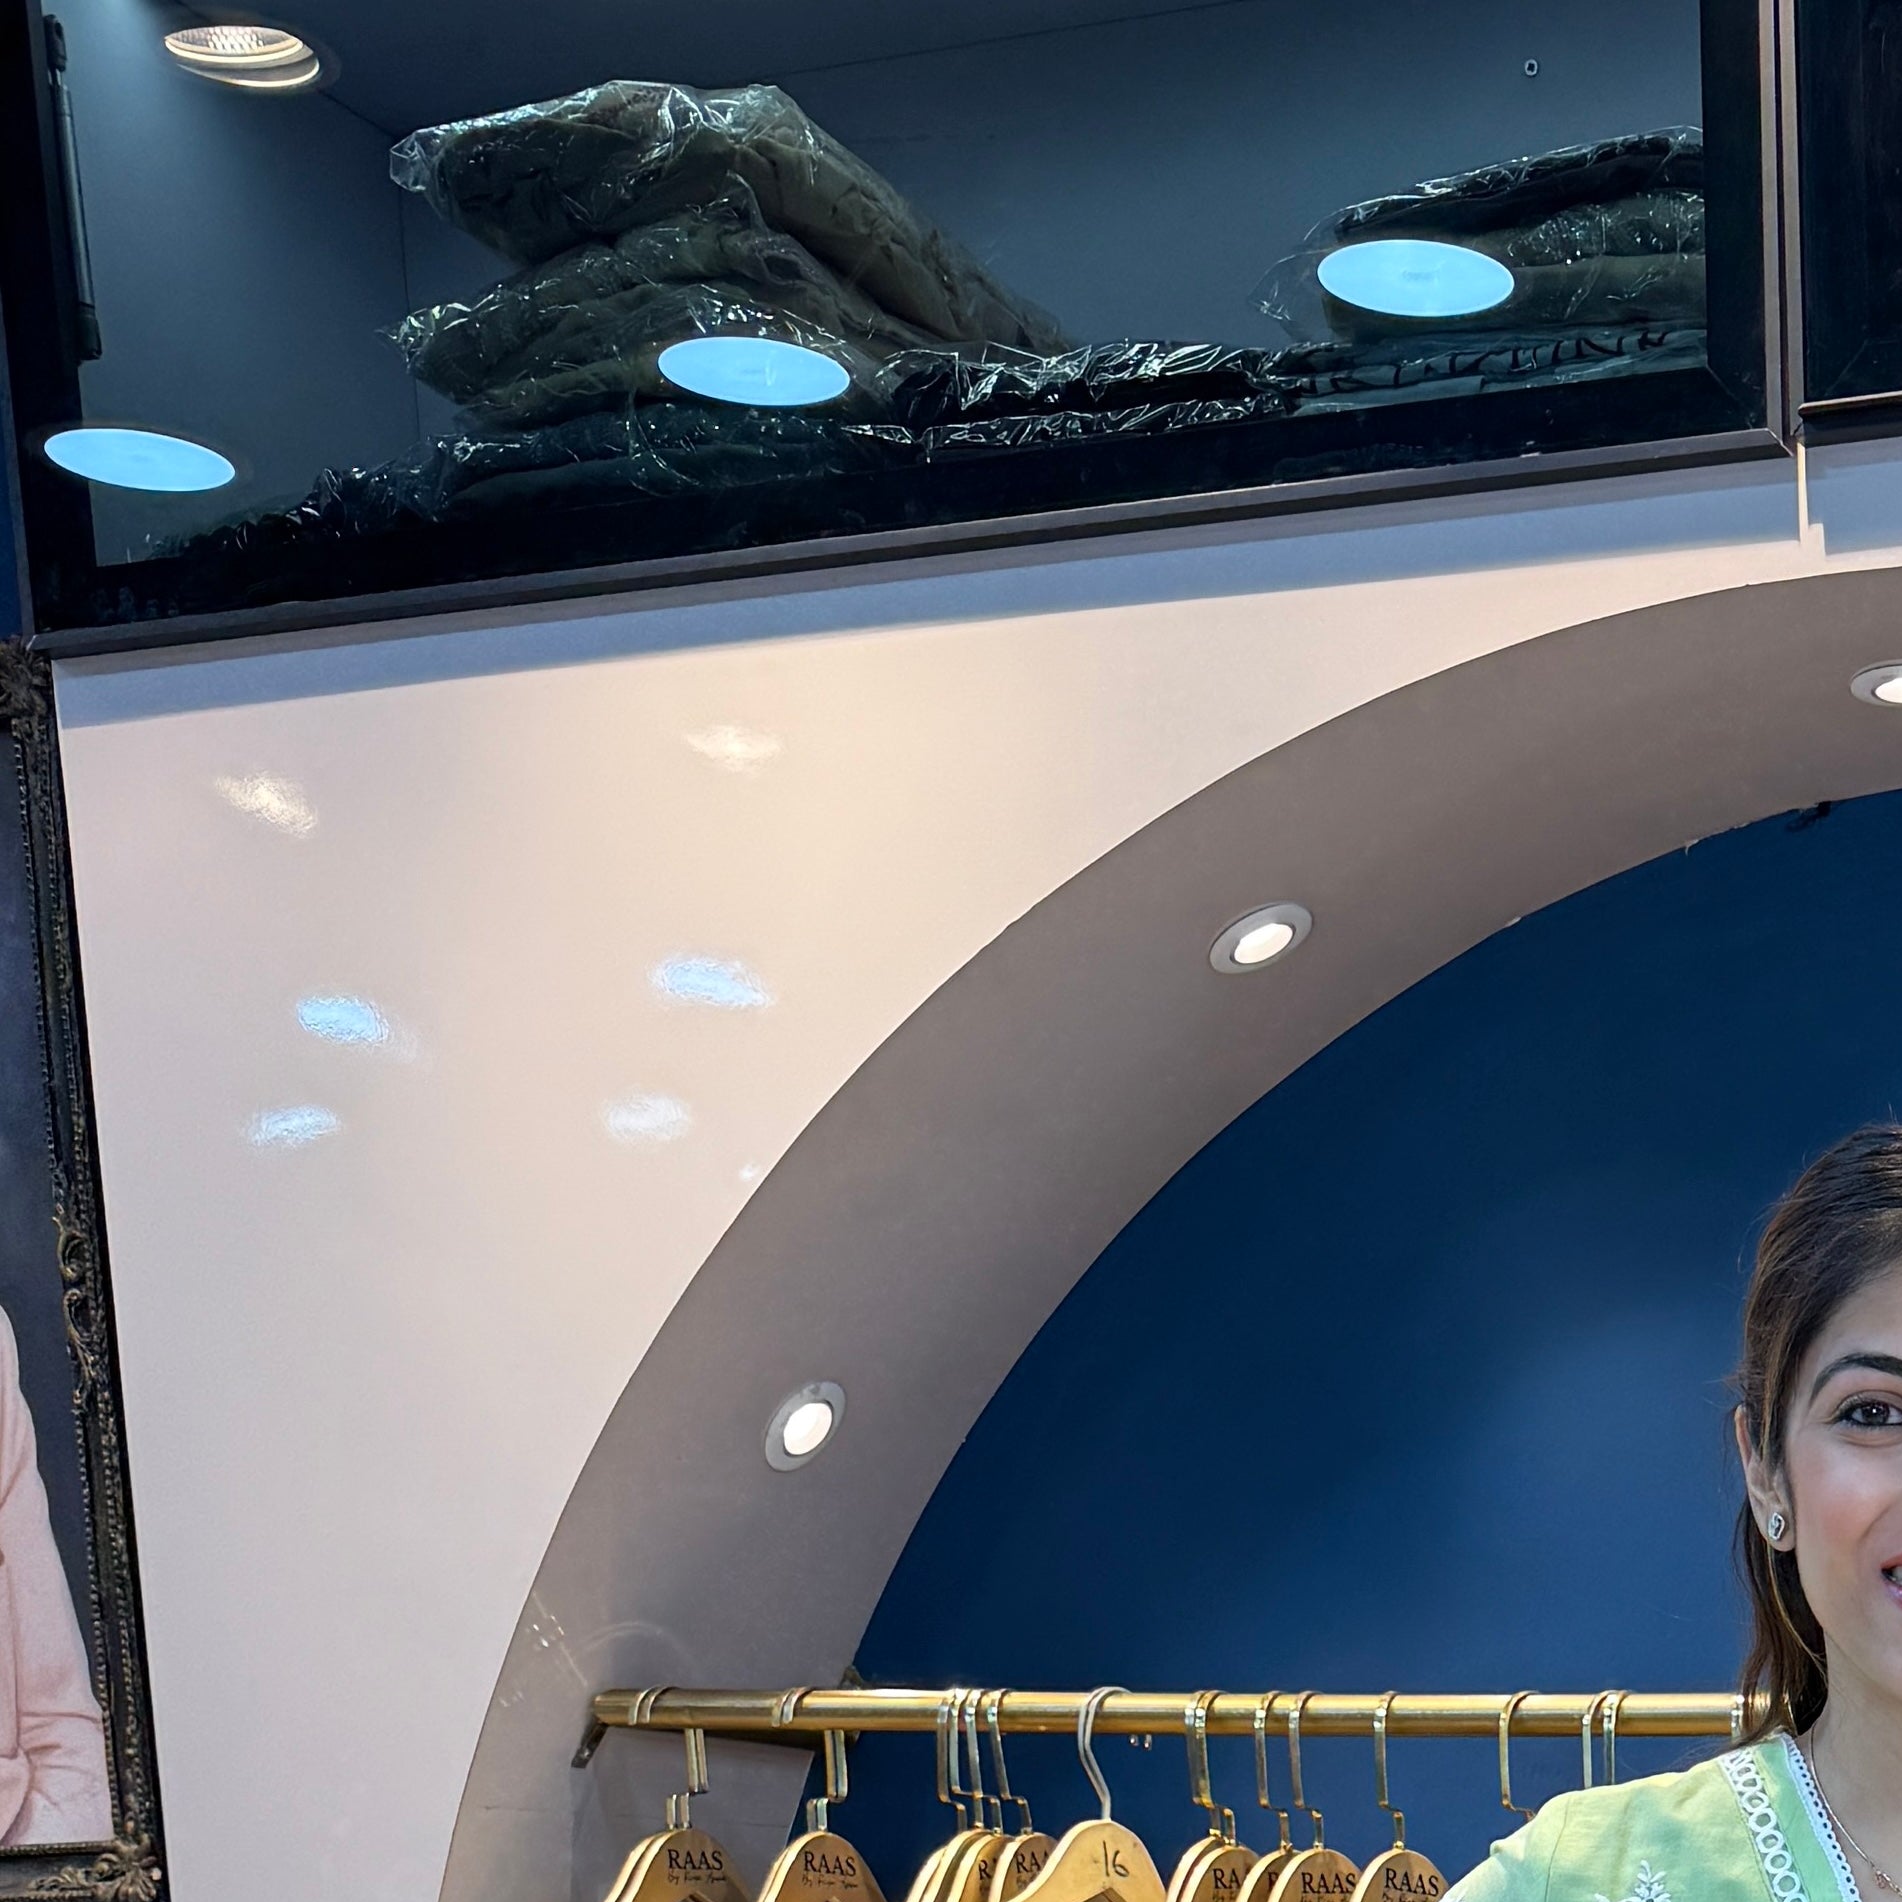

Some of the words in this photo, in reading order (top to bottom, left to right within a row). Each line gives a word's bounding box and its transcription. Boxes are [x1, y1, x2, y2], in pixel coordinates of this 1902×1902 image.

[667, 1849, 723, 1870] RAAS
[804, 1851, 856, 1877] RAAS
[1016, 1851, 1050, 1874] RA
[1103, 1840, 1130, 1877] 16
[1301, 1872, 1357, 1894] RAAS
[1385, 1868, 1439, 1897] RAAS
